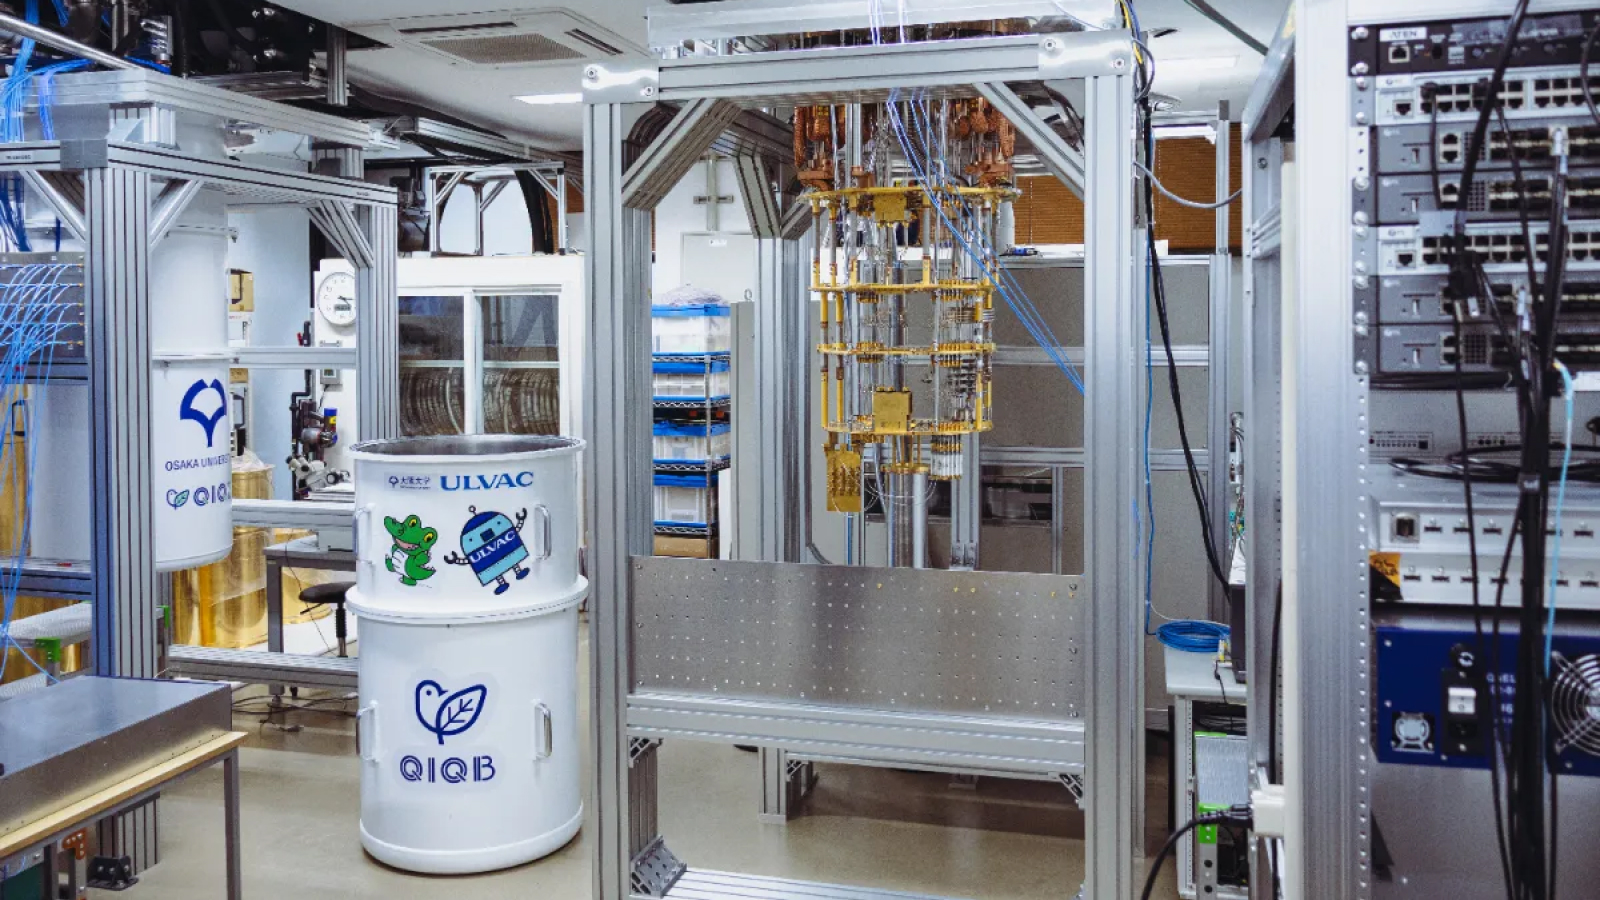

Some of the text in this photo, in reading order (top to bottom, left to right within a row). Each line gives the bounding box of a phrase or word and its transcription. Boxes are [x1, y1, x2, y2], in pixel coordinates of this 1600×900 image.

[165, 458, 199, 471] OSAKA
[440, 471, 534, 491] ULVAC
[469, 530, 516, 564] ULVAC
[399, 755, 496, 784] QIQB
